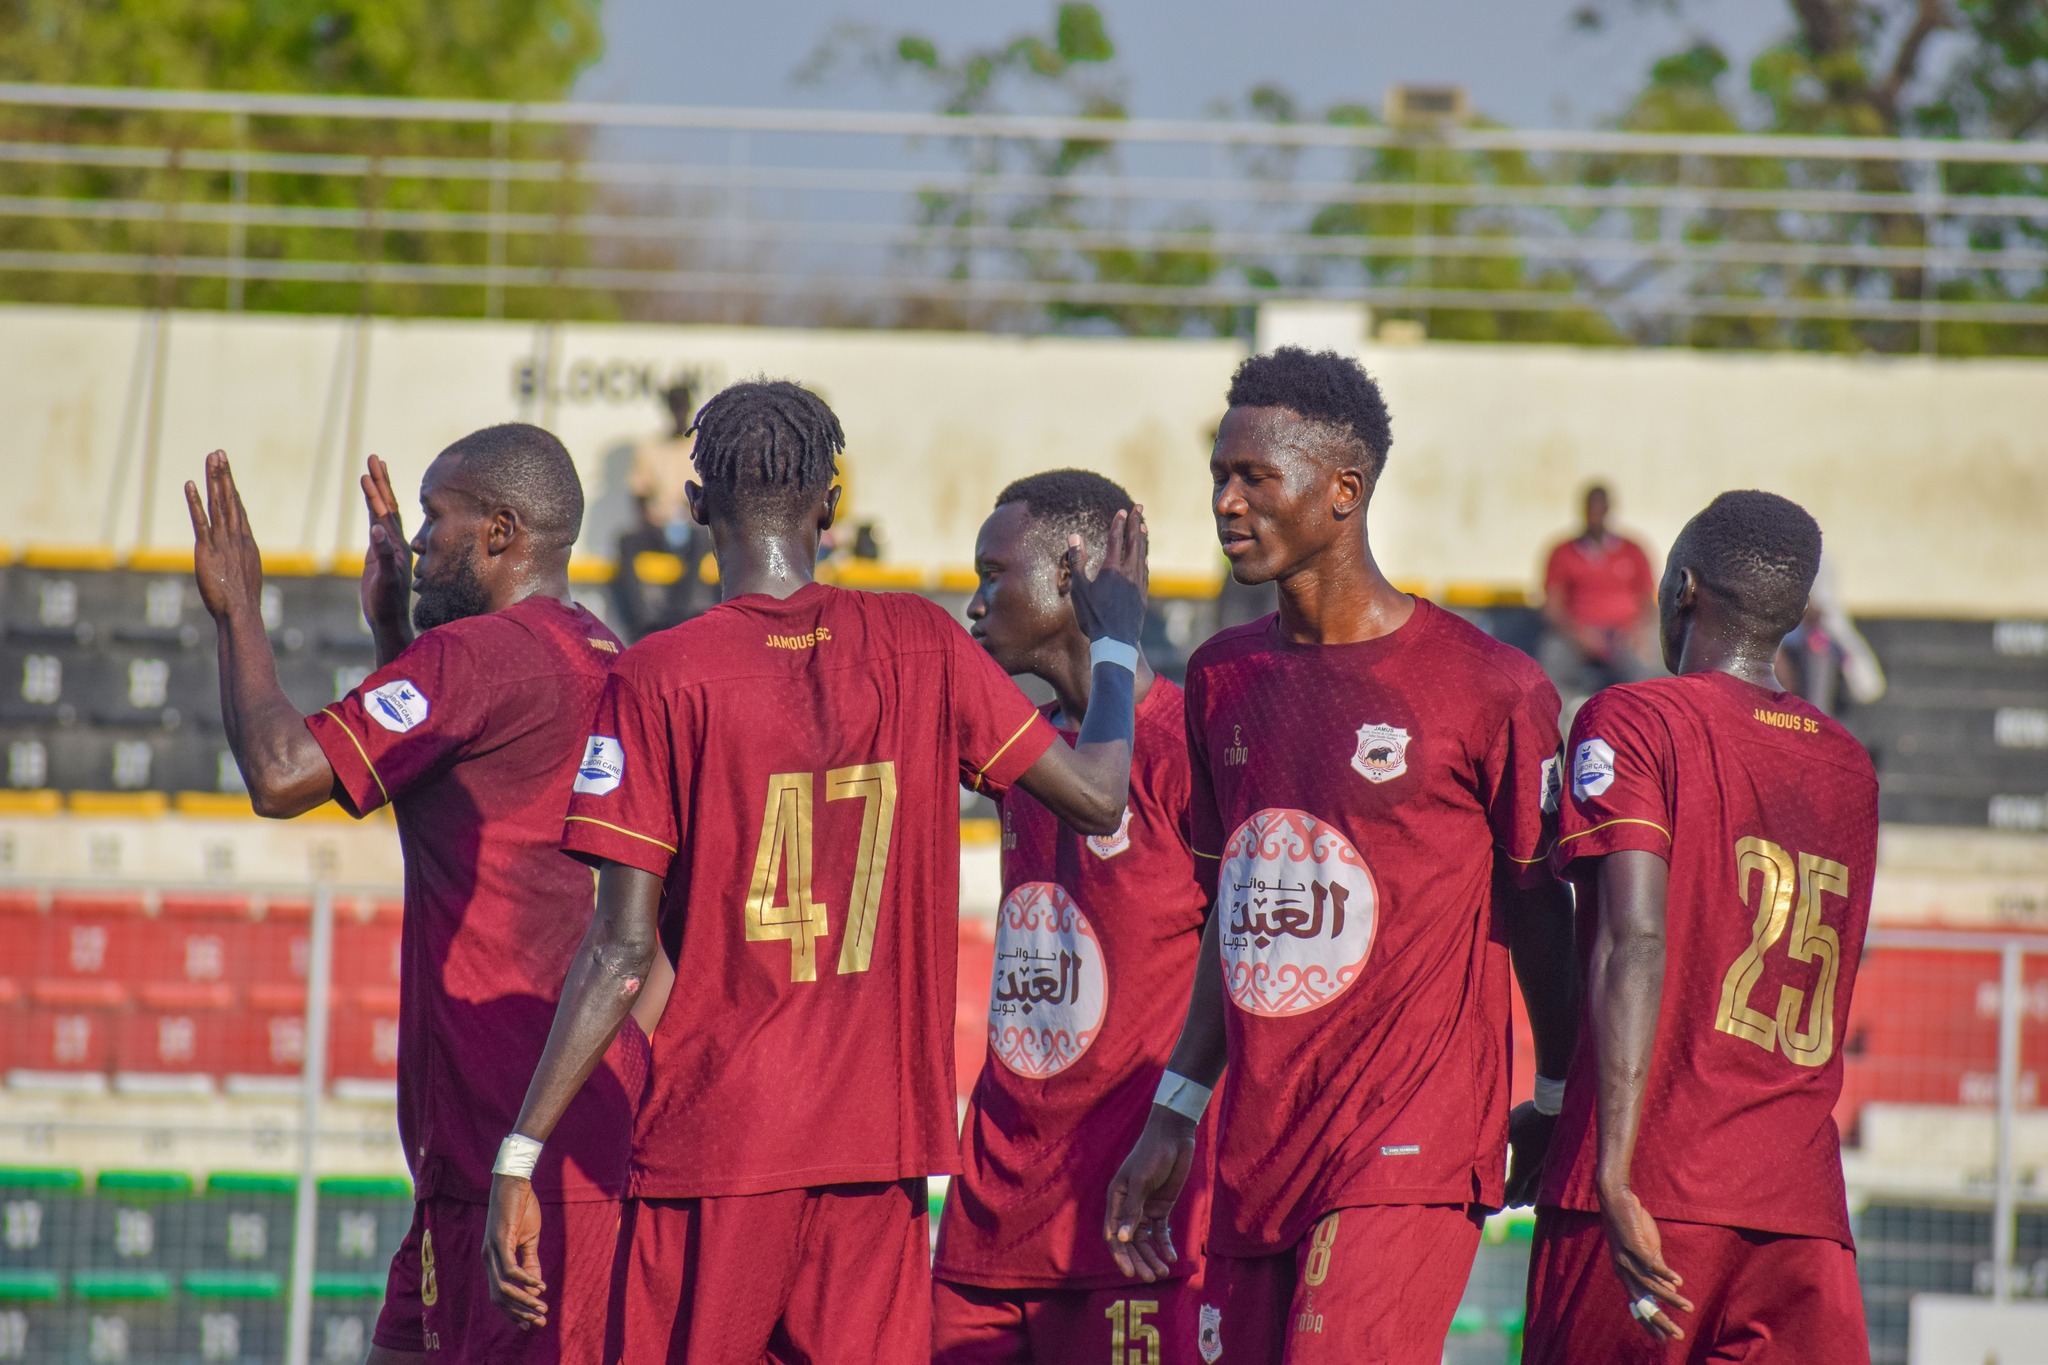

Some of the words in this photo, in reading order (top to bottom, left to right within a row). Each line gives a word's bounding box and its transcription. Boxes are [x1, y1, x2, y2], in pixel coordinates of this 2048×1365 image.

[766, 634, 815, 650] JAMOUS
[816, 627, 832, 640] SC
[401, 708, 415, 727] CARE
[1753, 708, 1801, 730] JAMOUS
[1804, 718, 1819, 733] SC
[602, 761, 621, 775] CARE
[1224, 747, 1249, 767] COPA
[745, 761, 898, 983] 47
[1714, 836, 1849, 1068] 25
[420, 1228, 438, 1307] 8
[1305, 1211, 1340, 1287] 8
[1105, 1299, 1160, 1365] 15
